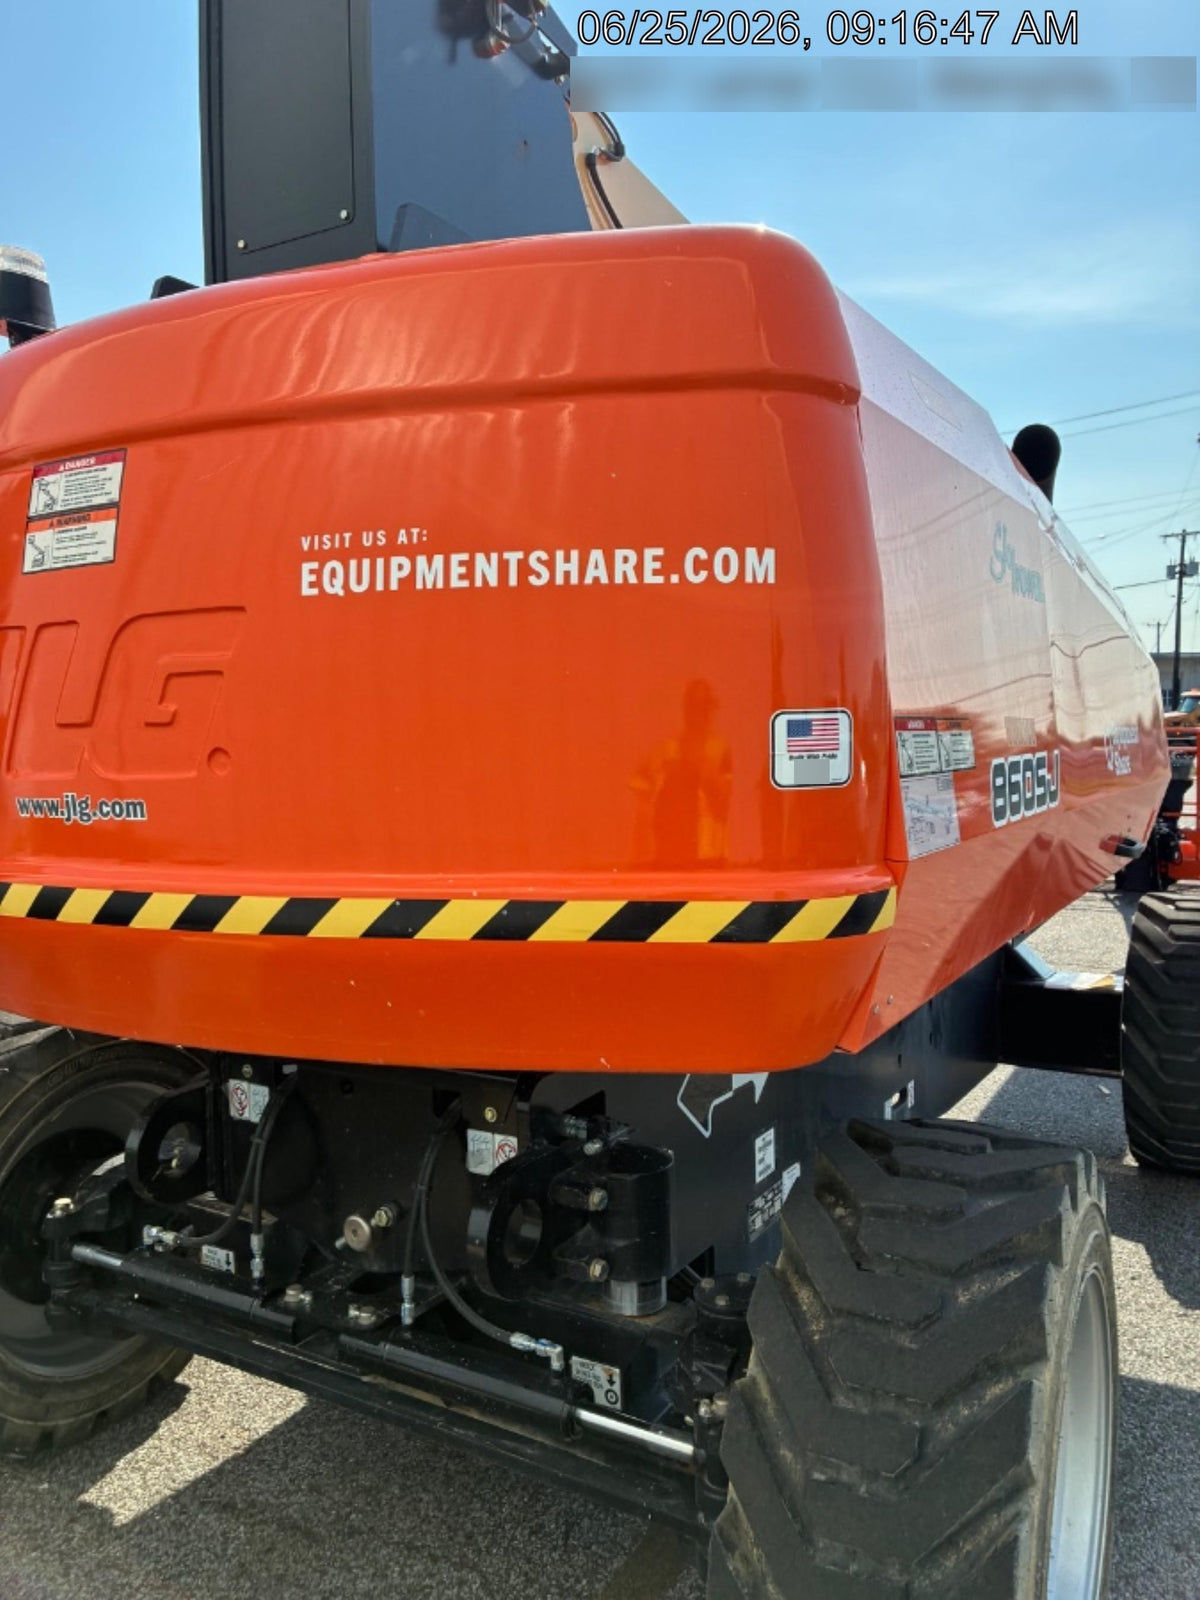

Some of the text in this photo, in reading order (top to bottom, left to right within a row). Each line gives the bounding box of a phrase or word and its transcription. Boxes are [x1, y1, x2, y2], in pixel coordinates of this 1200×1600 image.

[301, 528, 428, 551] VISIT US AT:
[301, 547, 776, 597] EQUIPMENTSHARE.COM
[16, 793, 146, 824] www.jlg.com
